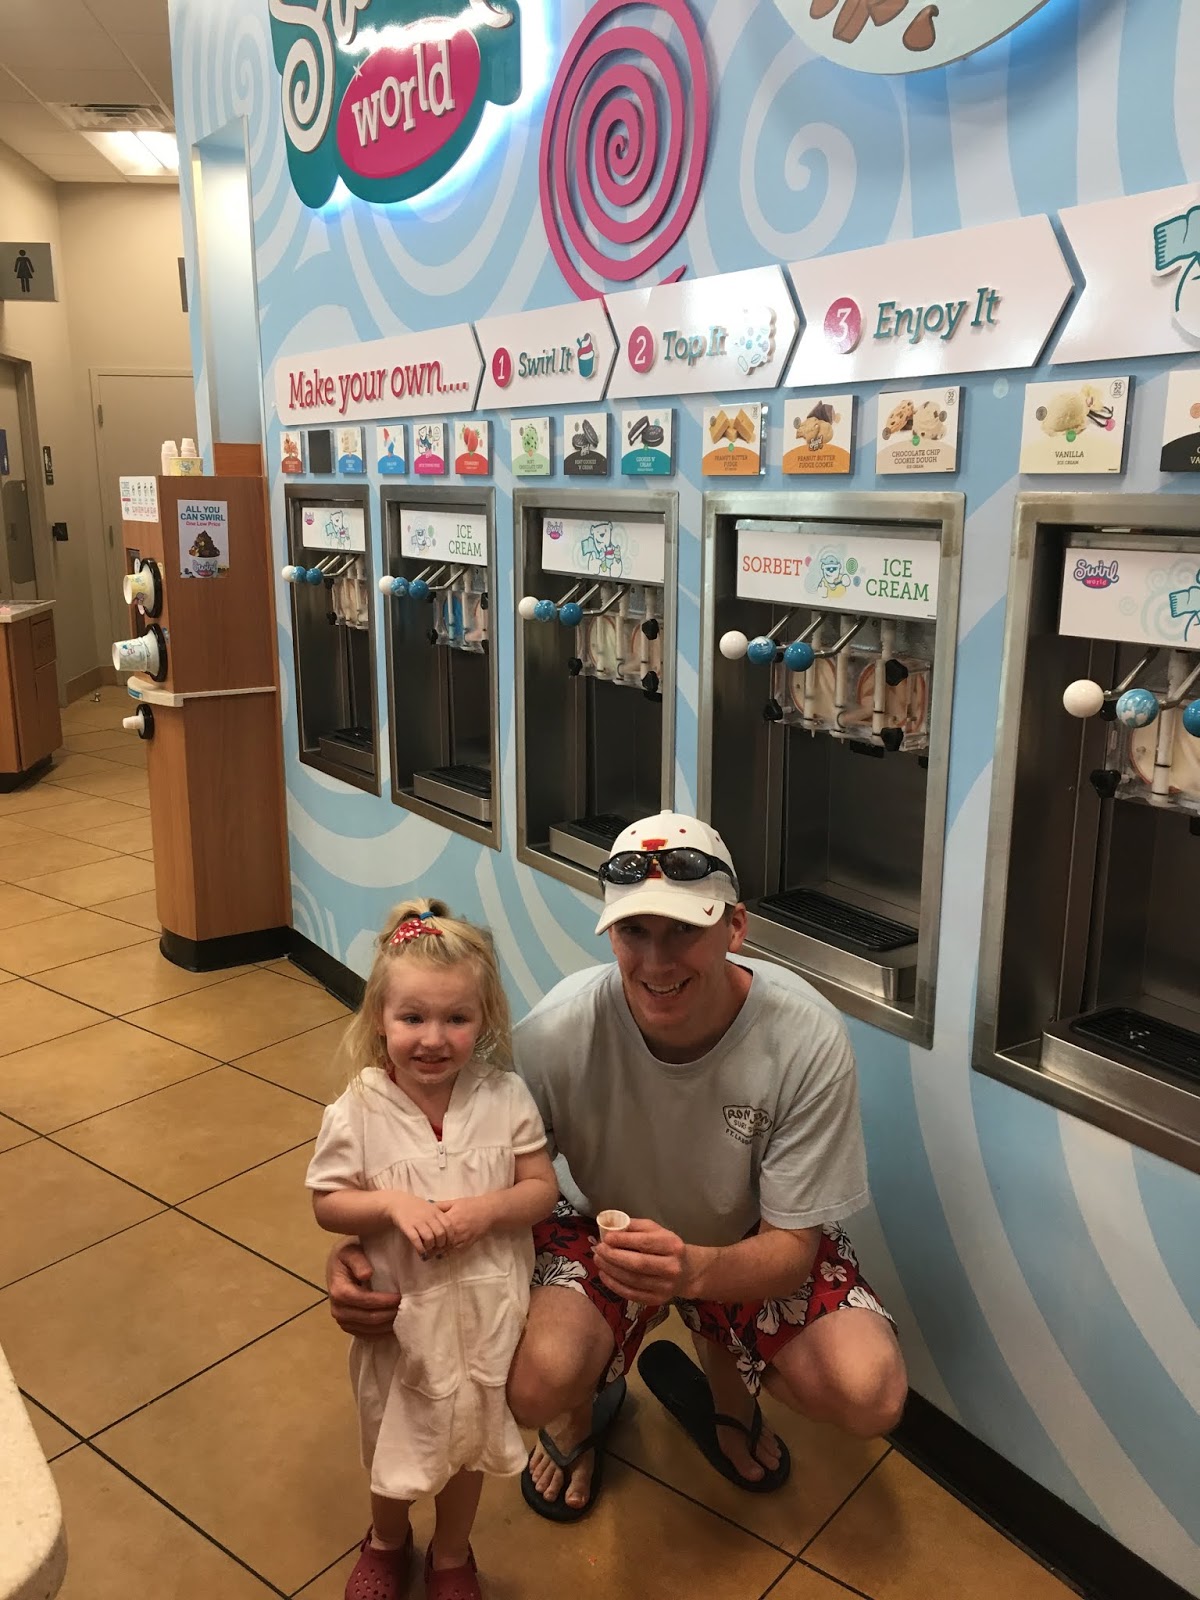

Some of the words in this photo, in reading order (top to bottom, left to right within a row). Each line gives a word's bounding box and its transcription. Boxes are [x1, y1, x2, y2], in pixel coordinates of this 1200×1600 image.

[351, 39, 455, 148] world
[873, 300, 967, 344] Enjoy
[970, 287, 1001, 327] It
[662, 330, 705, 366] Top
[706, 325, 728, 357] It
[518, 348, 555, 378] Swirl
[559, 346, 572, 373] It
[289, 369, 335, 409] Make
[338, 368, 386, 414] your
[391, 360, 467, 398] own....
[891, 449, 926, 458] CHOCOLATE
[926, 448, 941, 456] CHIP
[1055, 450, 1085, 458] VANILLA
[186, 505, 202, 513] ALL
[200, 513, 226, 521] SWIRL
[456, 524, 472, 539] ICE
[448, 540, 482, 557] CREAM
[742, 555, 803, 577] SORBET
[883, 558, 912, 578] ICE
[1074, 559, 1119, 583] Swirl
[866, 578, 929, 602] CREAM
[728, 1109, 751, 1120] RON
